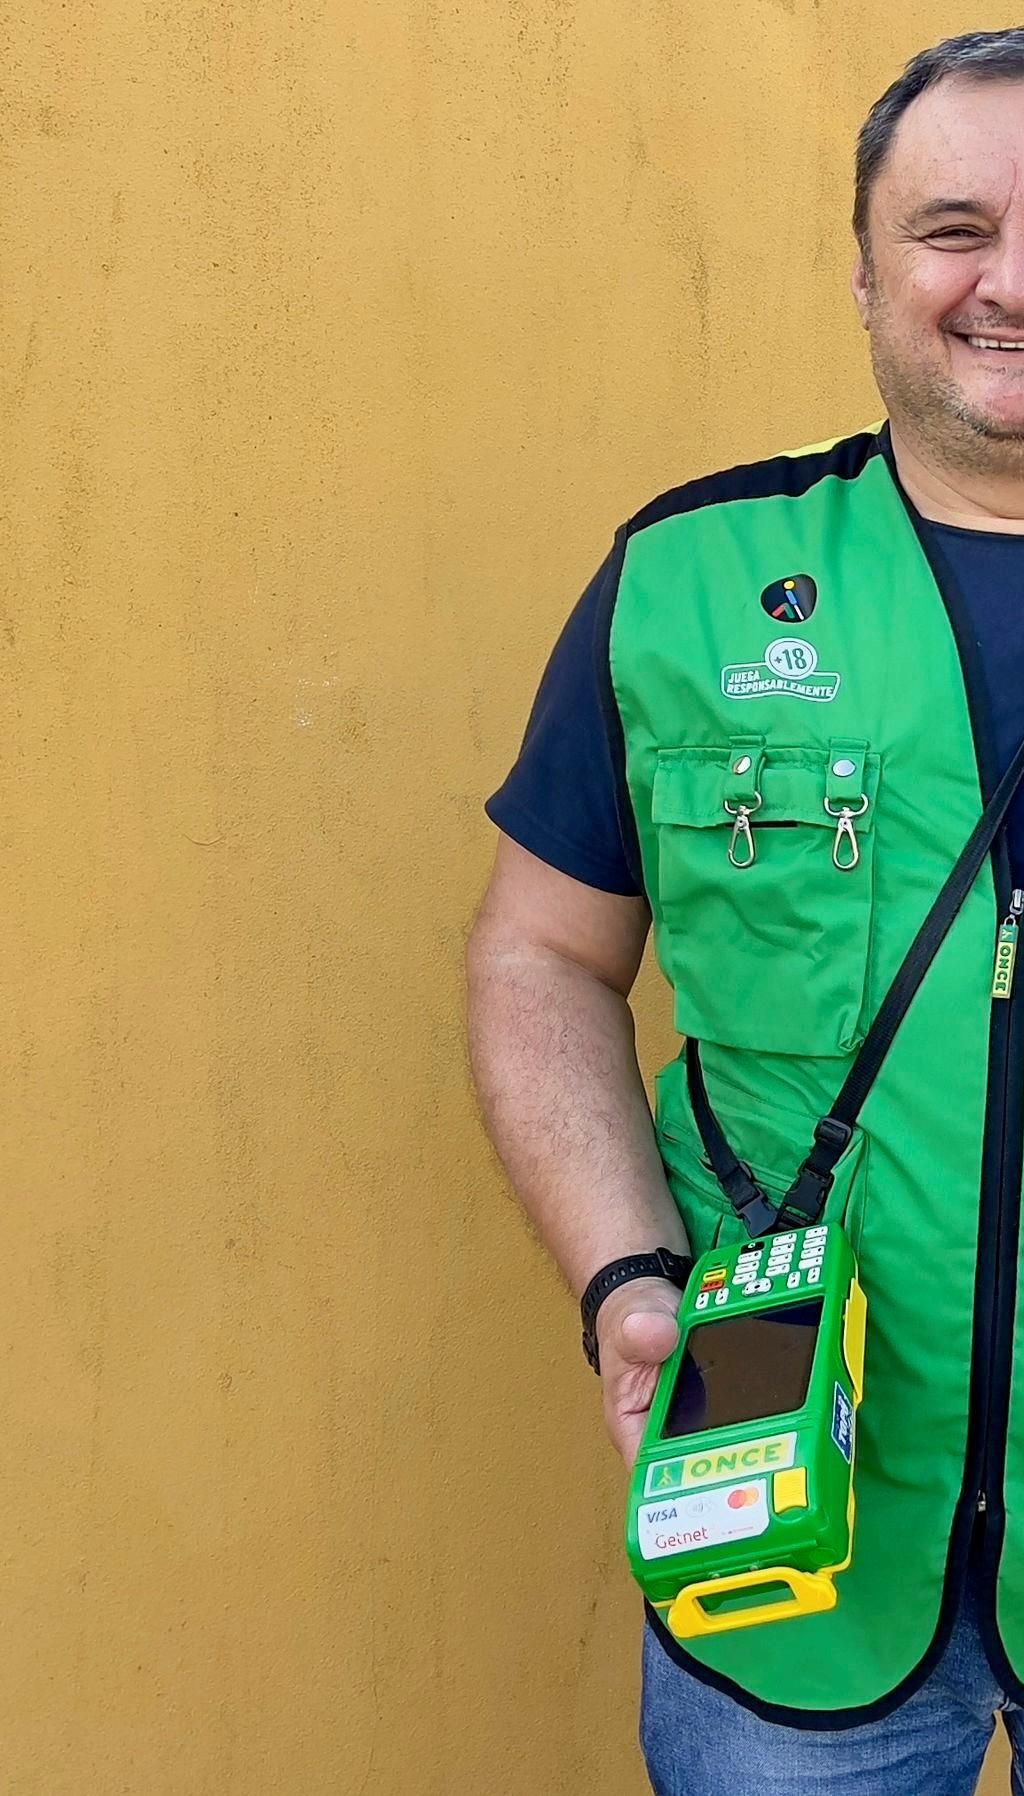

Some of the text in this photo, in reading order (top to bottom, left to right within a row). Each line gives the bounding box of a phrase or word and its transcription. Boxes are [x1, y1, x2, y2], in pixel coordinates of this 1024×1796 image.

[773, 648, 807, 670] +18
[728, 670, 760, 683] JUEGA
[727, 678, 834, 697] RESPONSABLEMENTE
[995, 945, 1011, 991] ONCE
[691, 1443, 782, 1477] ONCE
[647, 1508, 678, 1524] VISA
